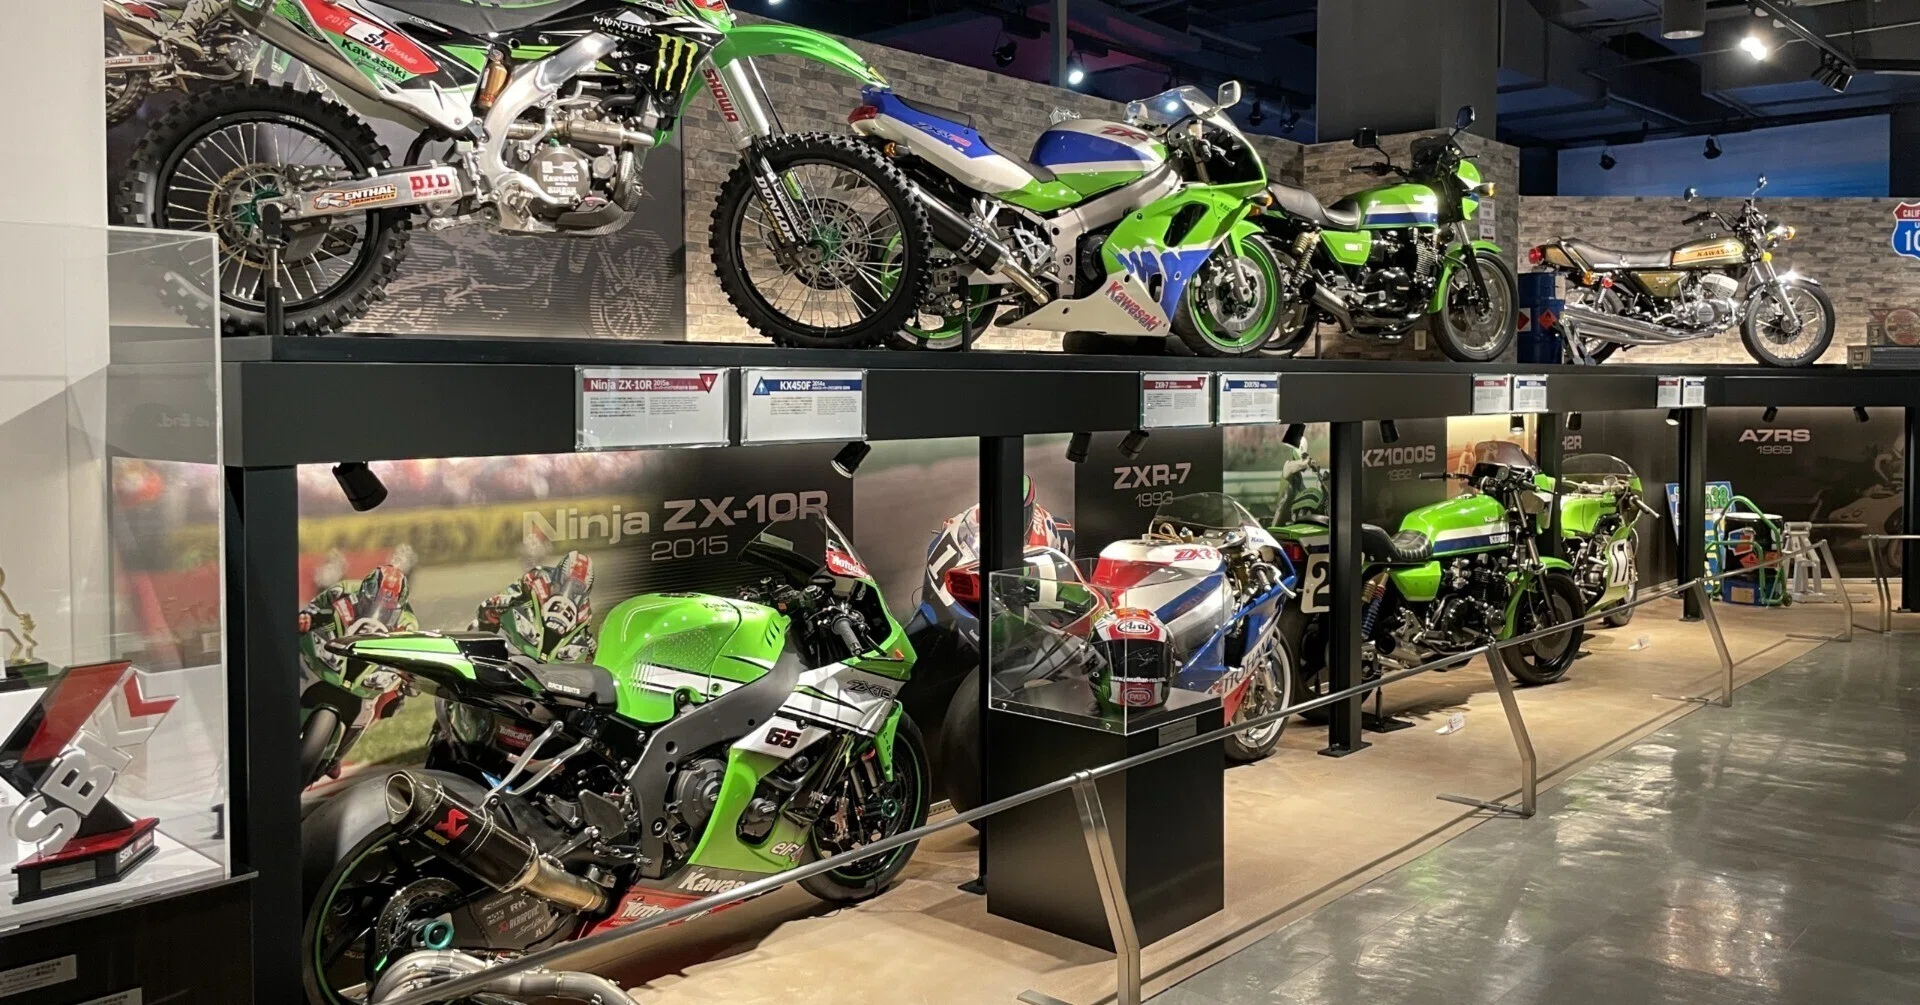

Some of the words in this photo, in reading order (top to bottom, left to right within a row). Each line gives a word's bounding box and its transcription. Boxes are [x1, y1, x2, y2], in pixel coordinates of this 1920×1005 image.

[593, 15, 652, 37] MONSTER
[341, 38, 407, 80] Kawasaki
[702, 68, 739, 123] SHOWA
[754, 174, 797, 244] DUNLOP
[1105, 280, 1162, 332] Kawasaki
[590, 379, 616, 392] Ninja
[618, 379, 652, 391] ZX-10R
[780, 380, 812, 391] KX450F
[1739, 429, 1810, 443] A7RS
[1362, 445, 1436, 468] KZ1000S
[1756, 445, 1793, 455] 1969
[1114, 462, 1191, 490] ZXR-7
[1135, 491, 1173, 508] 1993
[522, 505, 650, 544] Ninja
[663, 490, 828, 532] ZX-10R
[651, 535, 729, 561] 2015
[547, 600, 576, 622] 65
[1125, 621, 1149, 631] Arai
[1129, 692, 1147, 701] PATA
[765, 727, 802, 749] 65
[8, 667, 180, 858] SBK
[678, 871, 746, 893] Kawas
[510, 899, 527, 912] RK
